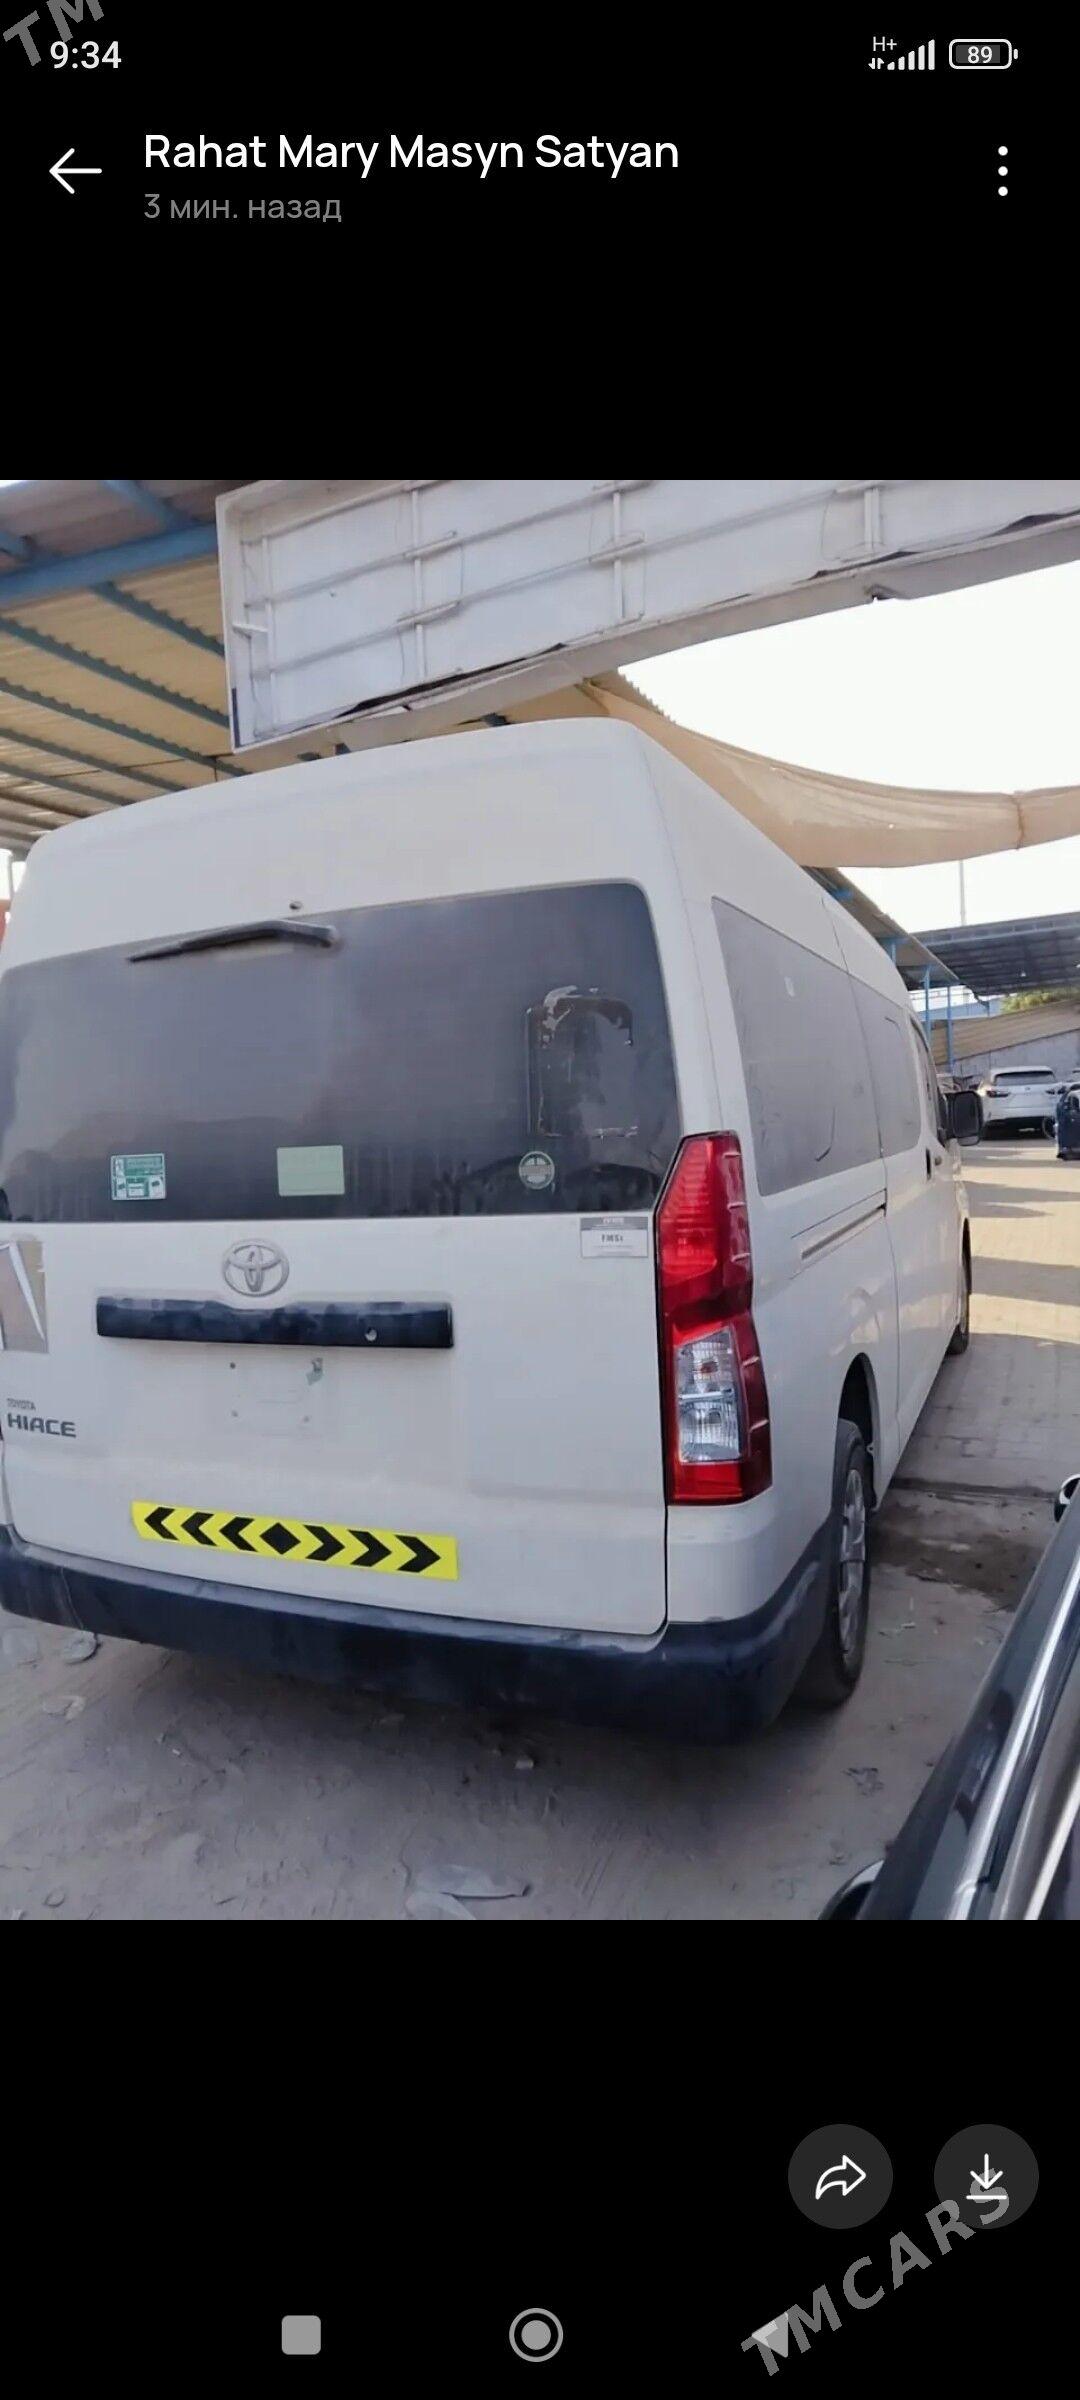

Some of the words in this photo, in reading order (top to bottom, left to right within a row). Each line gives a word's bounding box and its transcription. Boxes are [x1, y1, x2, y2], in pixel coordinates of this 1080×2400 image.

[50, 40, 122, 69] 9:34
[872, 36, 898, 52] H+
[967, 45, 993, 64] 89
[145, 134, 267, 168] Rahat
[279, 134, 380, 179] Mary
[390, 134, 524, 179] Masyn
[535, 134, 679, 179] Satyan
[144, 193, 161, 219] 3
[170, 199, 238, 219] мин.
[248, 199, 342, 223] назад
[7, 1413, 77, 1438] HIACE
